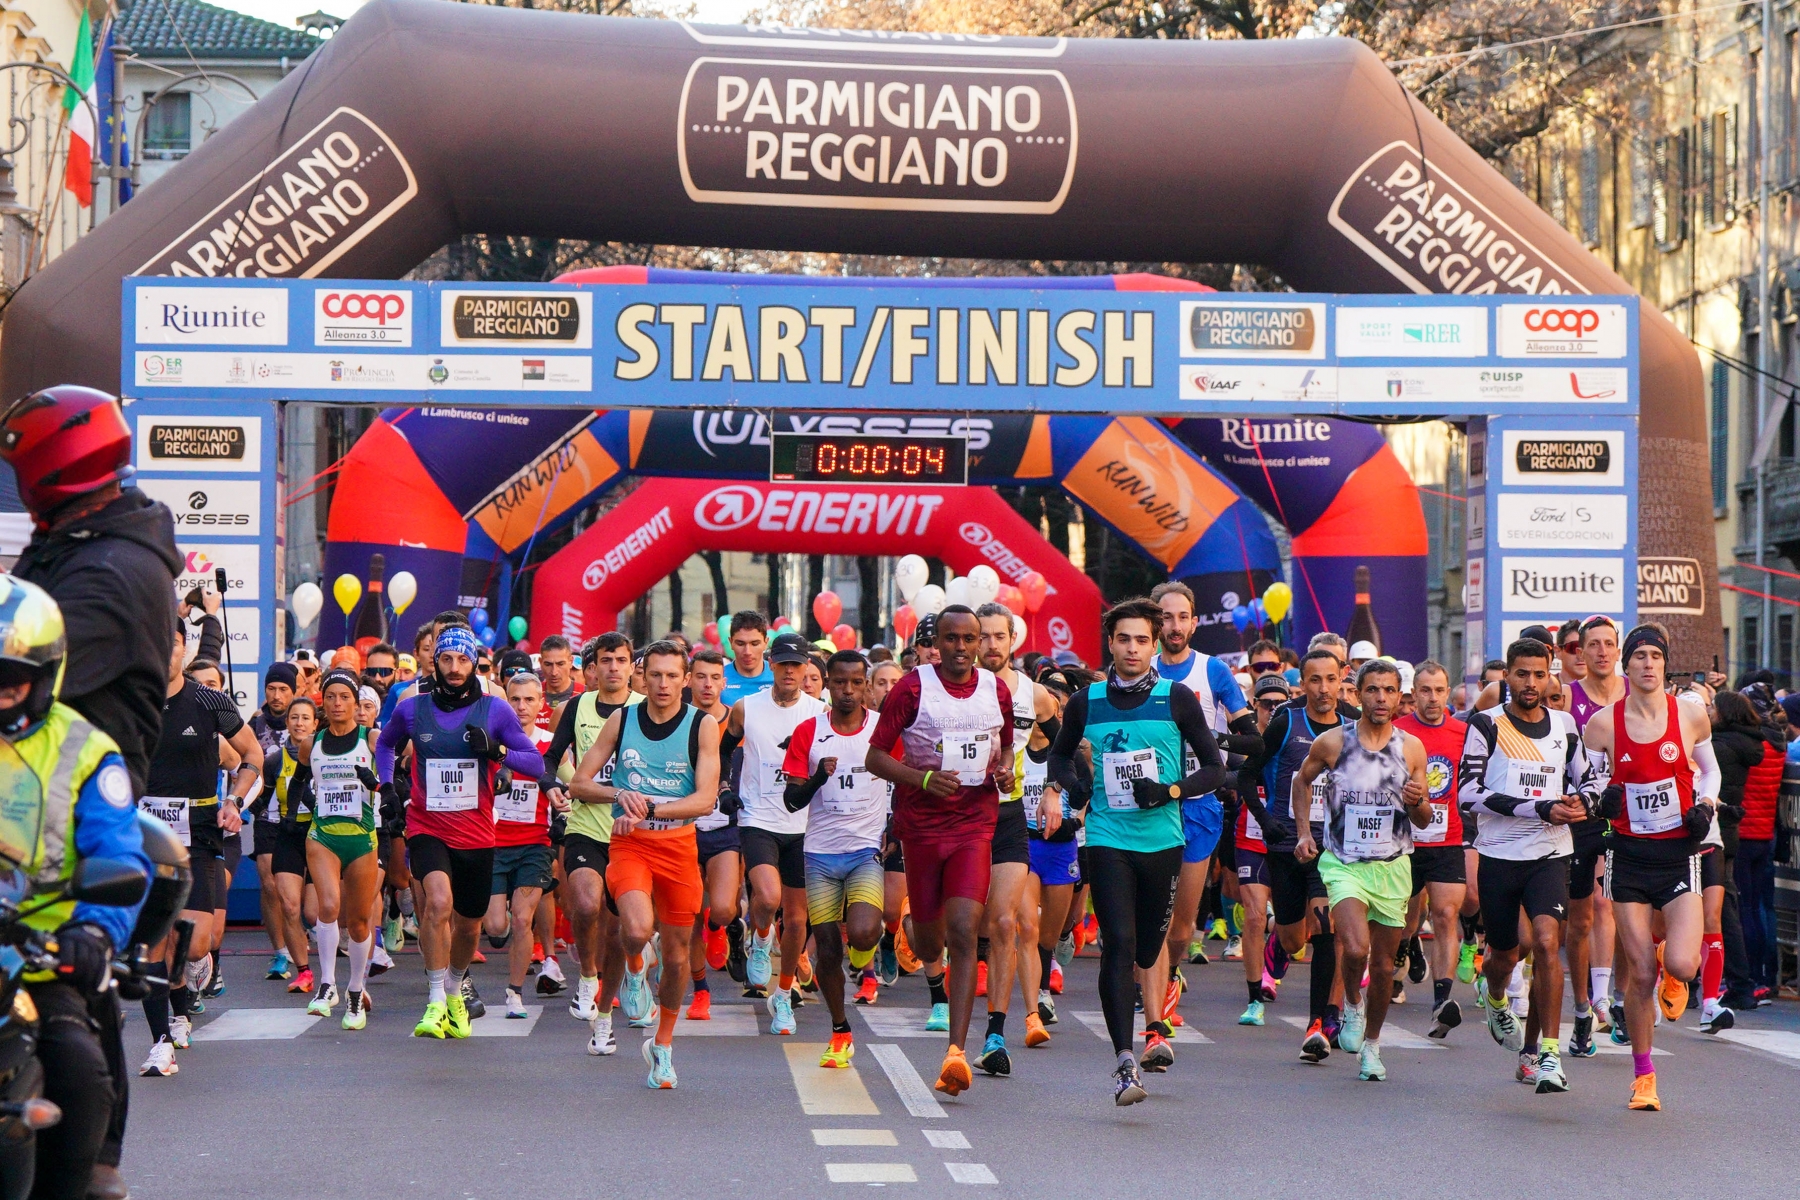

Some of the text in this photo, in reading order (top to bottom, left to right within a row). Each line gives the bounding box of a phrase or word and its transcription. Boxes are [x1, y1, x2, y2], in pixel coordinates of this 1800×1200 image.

[716, 75, 1042, 133] PARMIGIANO
[745, 130, 1009, 187] REGGIANO
[156, 131, 361, 279] RMIGIANO
[1383, 160, 1573, 295] PARMIGIA
[1374, 203, 1498, 295] REGGI
[322, 293, 405, 326] coop
[462, 298, 571, 318] PARMIGIANO
[161, 302, 267, 335] Riunite
[472, 317, 560, 335] REGGIANO
[1199, 310, 1306, 331] PARMIGIANO
[1524, 308, 1599, 339] coop
[324, 329, 386, 341] Alleanza 3.0
[1210, 328, 1296, 346] REGGIANO
[614, 302, 1155, 389] START/FINISH
[1526, 342, 1584, 352] Alleanza 3.0
[343, 367, 395, 378] PROVINCIA
[1493, 372, 1524, 382] UISP
[1210, 380, 1242, 390] IAAF
[429, 407, 485, 422] Lambrusco
[486, 411, 496, 422] ci
[496, 413, 530, 426] unisce
[156, 427, 239, 443] PARMIGIANO
[1220, 417, 1332, 450] Riunite
[163, 440, 230, 456] REGGIANO
[1522, 442, 1604, 457] PARMIGIANO
[817, 444, 945, 475] 0:00:04
[1233, 455, 1284, 468] Lambrusco
[1297, 455, 1331, 468] unisce
[1530, 455, 1597, 471] REGGIANO
[175, 513, 250, 526] YSSES
[758, 490, 945, 536] ENERVIT
[1530, 506, 1567, 523] Ford
[605, 506, 675, 574] ENERVIT
[1506, 529, 1614, 541] SEVERI&SCORCIONI
[1510, 567, 1616, 600] Riunite
[1637, 582, 1689, 605] GIANO
[927, 716, 965, 730] LIBERTAS
[960, 743, 977, 760] 15
[1115, 763, 1144, 781] PACER
[1186, 759, 1196, 772] RA
[440, 770, 464, 785] LOLLO
[641, 776, 682, 786] ENERGY
[837, 774, 855, 790] 14
[1119, 780, 1131, 791] 13
[1518, 772, 1548, 789] NOUINI
[444, 784, 450, 794] 6
[1023, 784, 1044, 797] APOS
[1341, 789, 1394, 806] BSI LUX
[1524, 787, 1530, 797] 9
[329, 804, 339, 813] F5
[1030, 798, 1039, 806] F2
[1634, 791, 1670, 811] 1729
[648, 822, 655, 831] 3
[1357, 817, 1383, 831] NASEF
[1361, 831, 1367, 840] 8
[1159, 874, 1179, 933] NIKE
